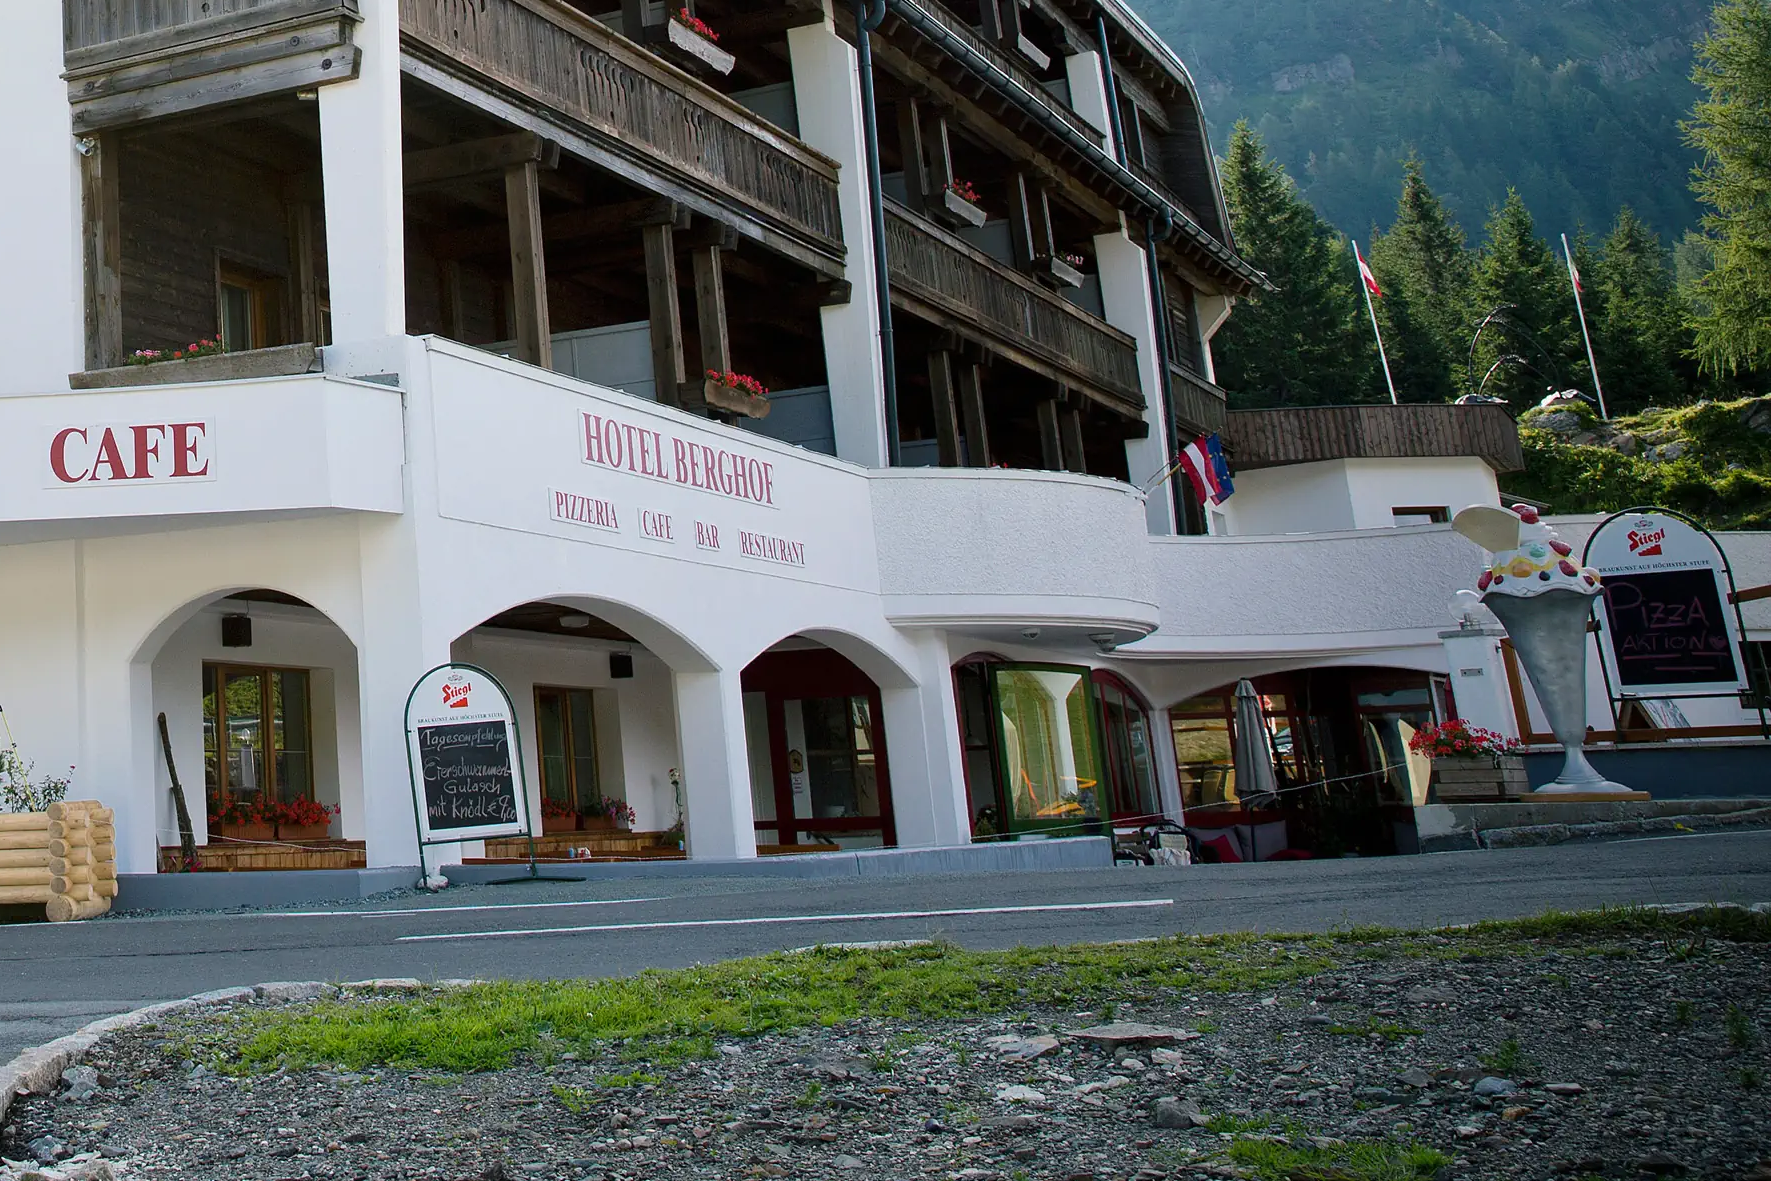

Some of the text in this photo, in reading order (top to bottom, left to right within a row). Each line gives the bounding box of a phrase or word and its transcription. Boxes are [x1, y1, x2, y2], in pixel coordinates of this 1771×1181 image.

[50, 422, 208, 482] CAFE
[582, 412, 774, 505] HOTEL BERGHOF
[555, 491, 805, 565] PIZZERIA CAFE BAR RESTAURANT
[1627, 528, 1665, 552] Stiegl
[442, 682, 472, 704] Stiegl
[443, 777, 501, 795] Gulasch
[428, 794, 447, 817] mit
[451, 795, 488, 820] Knödl
